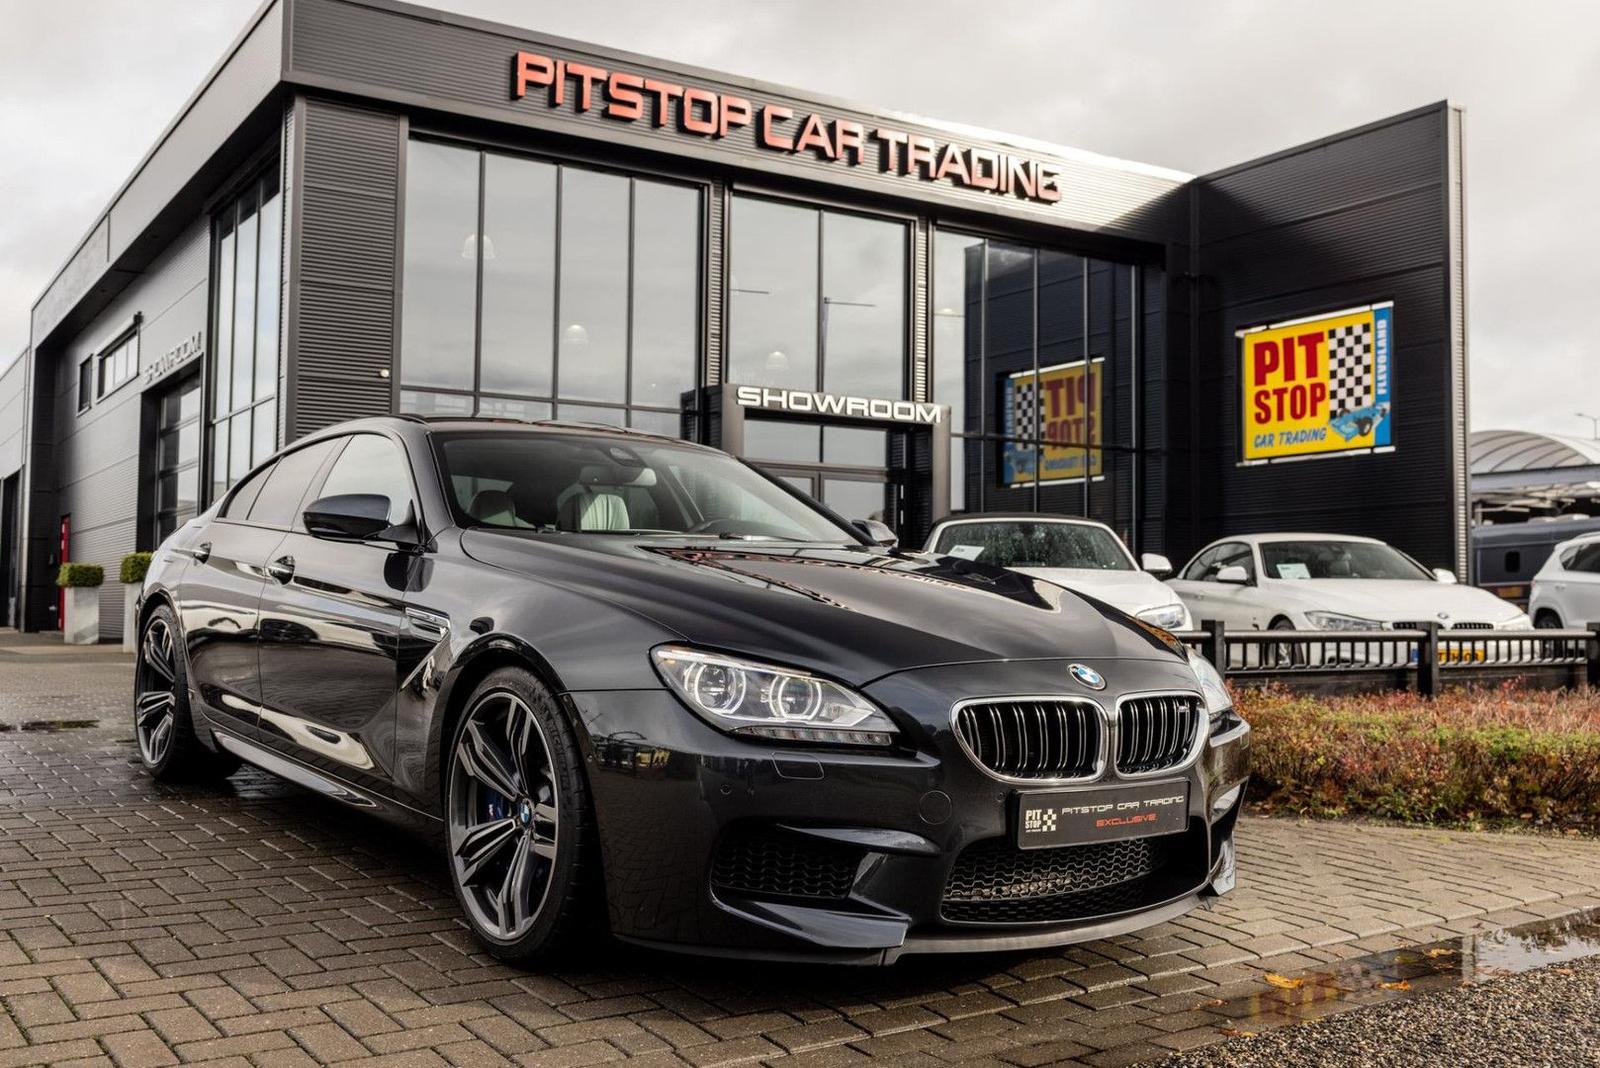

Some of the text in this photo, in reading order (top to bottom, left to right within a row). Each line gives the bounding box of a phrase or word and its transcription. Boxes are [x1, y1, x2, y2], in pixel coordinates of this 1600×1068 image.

[514, 51, 1063, 202] PITSTOP CAR TRADING
[1254, 332, 1324, 386] PIT
[1376, 319, 1387, 395] FLEVOLAND
[737, 386, 941, 423] SHOWROOM
[1254, 383, 1326, 425] STOP
[1254, 428, 1327, 448] CAR TRADING
[1025, 810, 1042, 820] PIT
[1061, 795, 1184, 815] PITSTOP CAR TRADING
[1025, 820, 1041, 829] STOP
[1096, 813, 1157, 827] EXCLUSIVE
